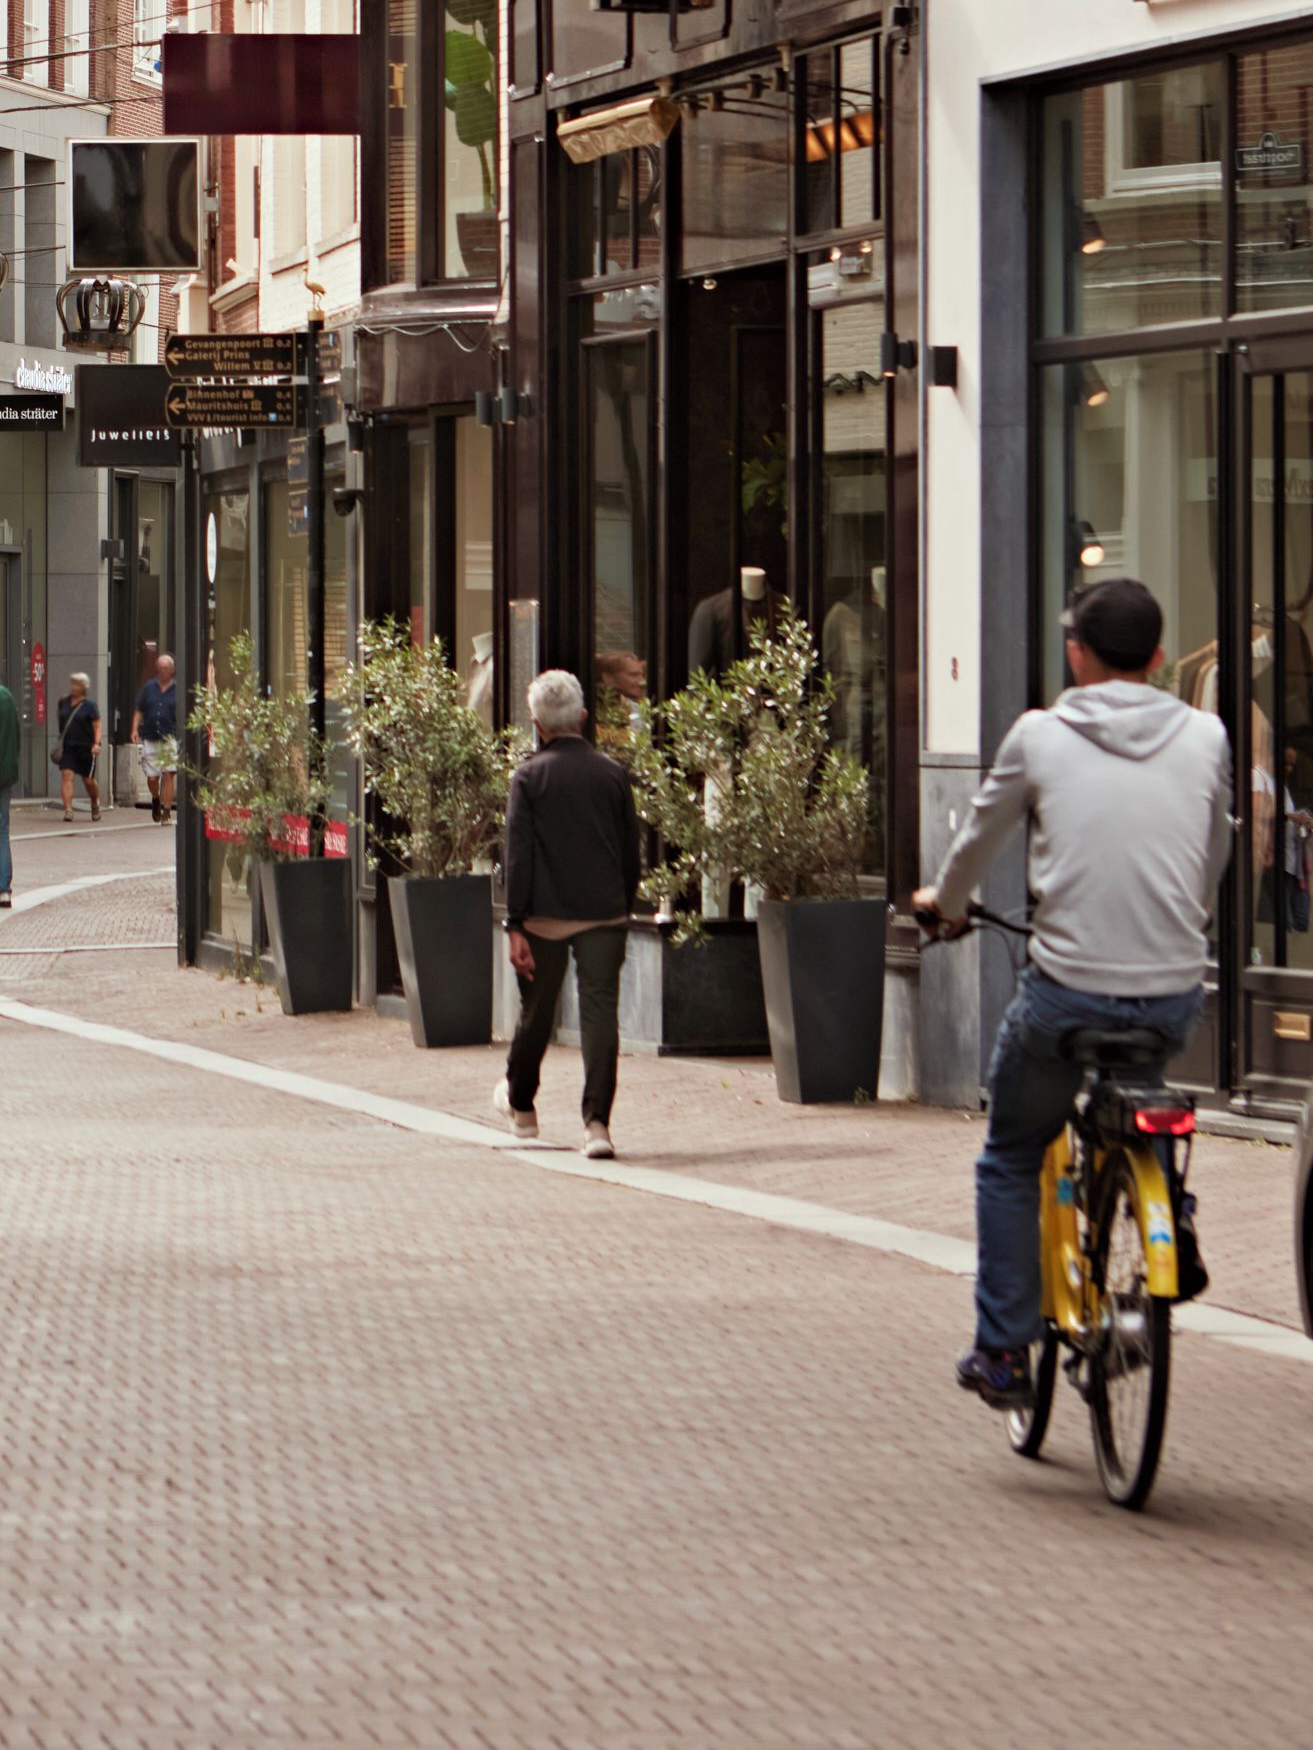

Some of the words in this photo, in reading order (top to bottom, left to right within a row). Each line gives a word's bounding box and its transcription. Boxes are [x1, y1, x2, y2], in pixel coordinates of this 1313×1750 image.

[185, 339, 261, 350] Gevangenpoort
[185, 350, 220, 361] Galerij
[223, 350, 250, 359] Prins
[214, 361, 250, 371] Willem
[187, 389, 240, 399] Binnenhof
[187, 401, 248, 411] Mauritshuis
[21, 407, 58, 420] sträter
